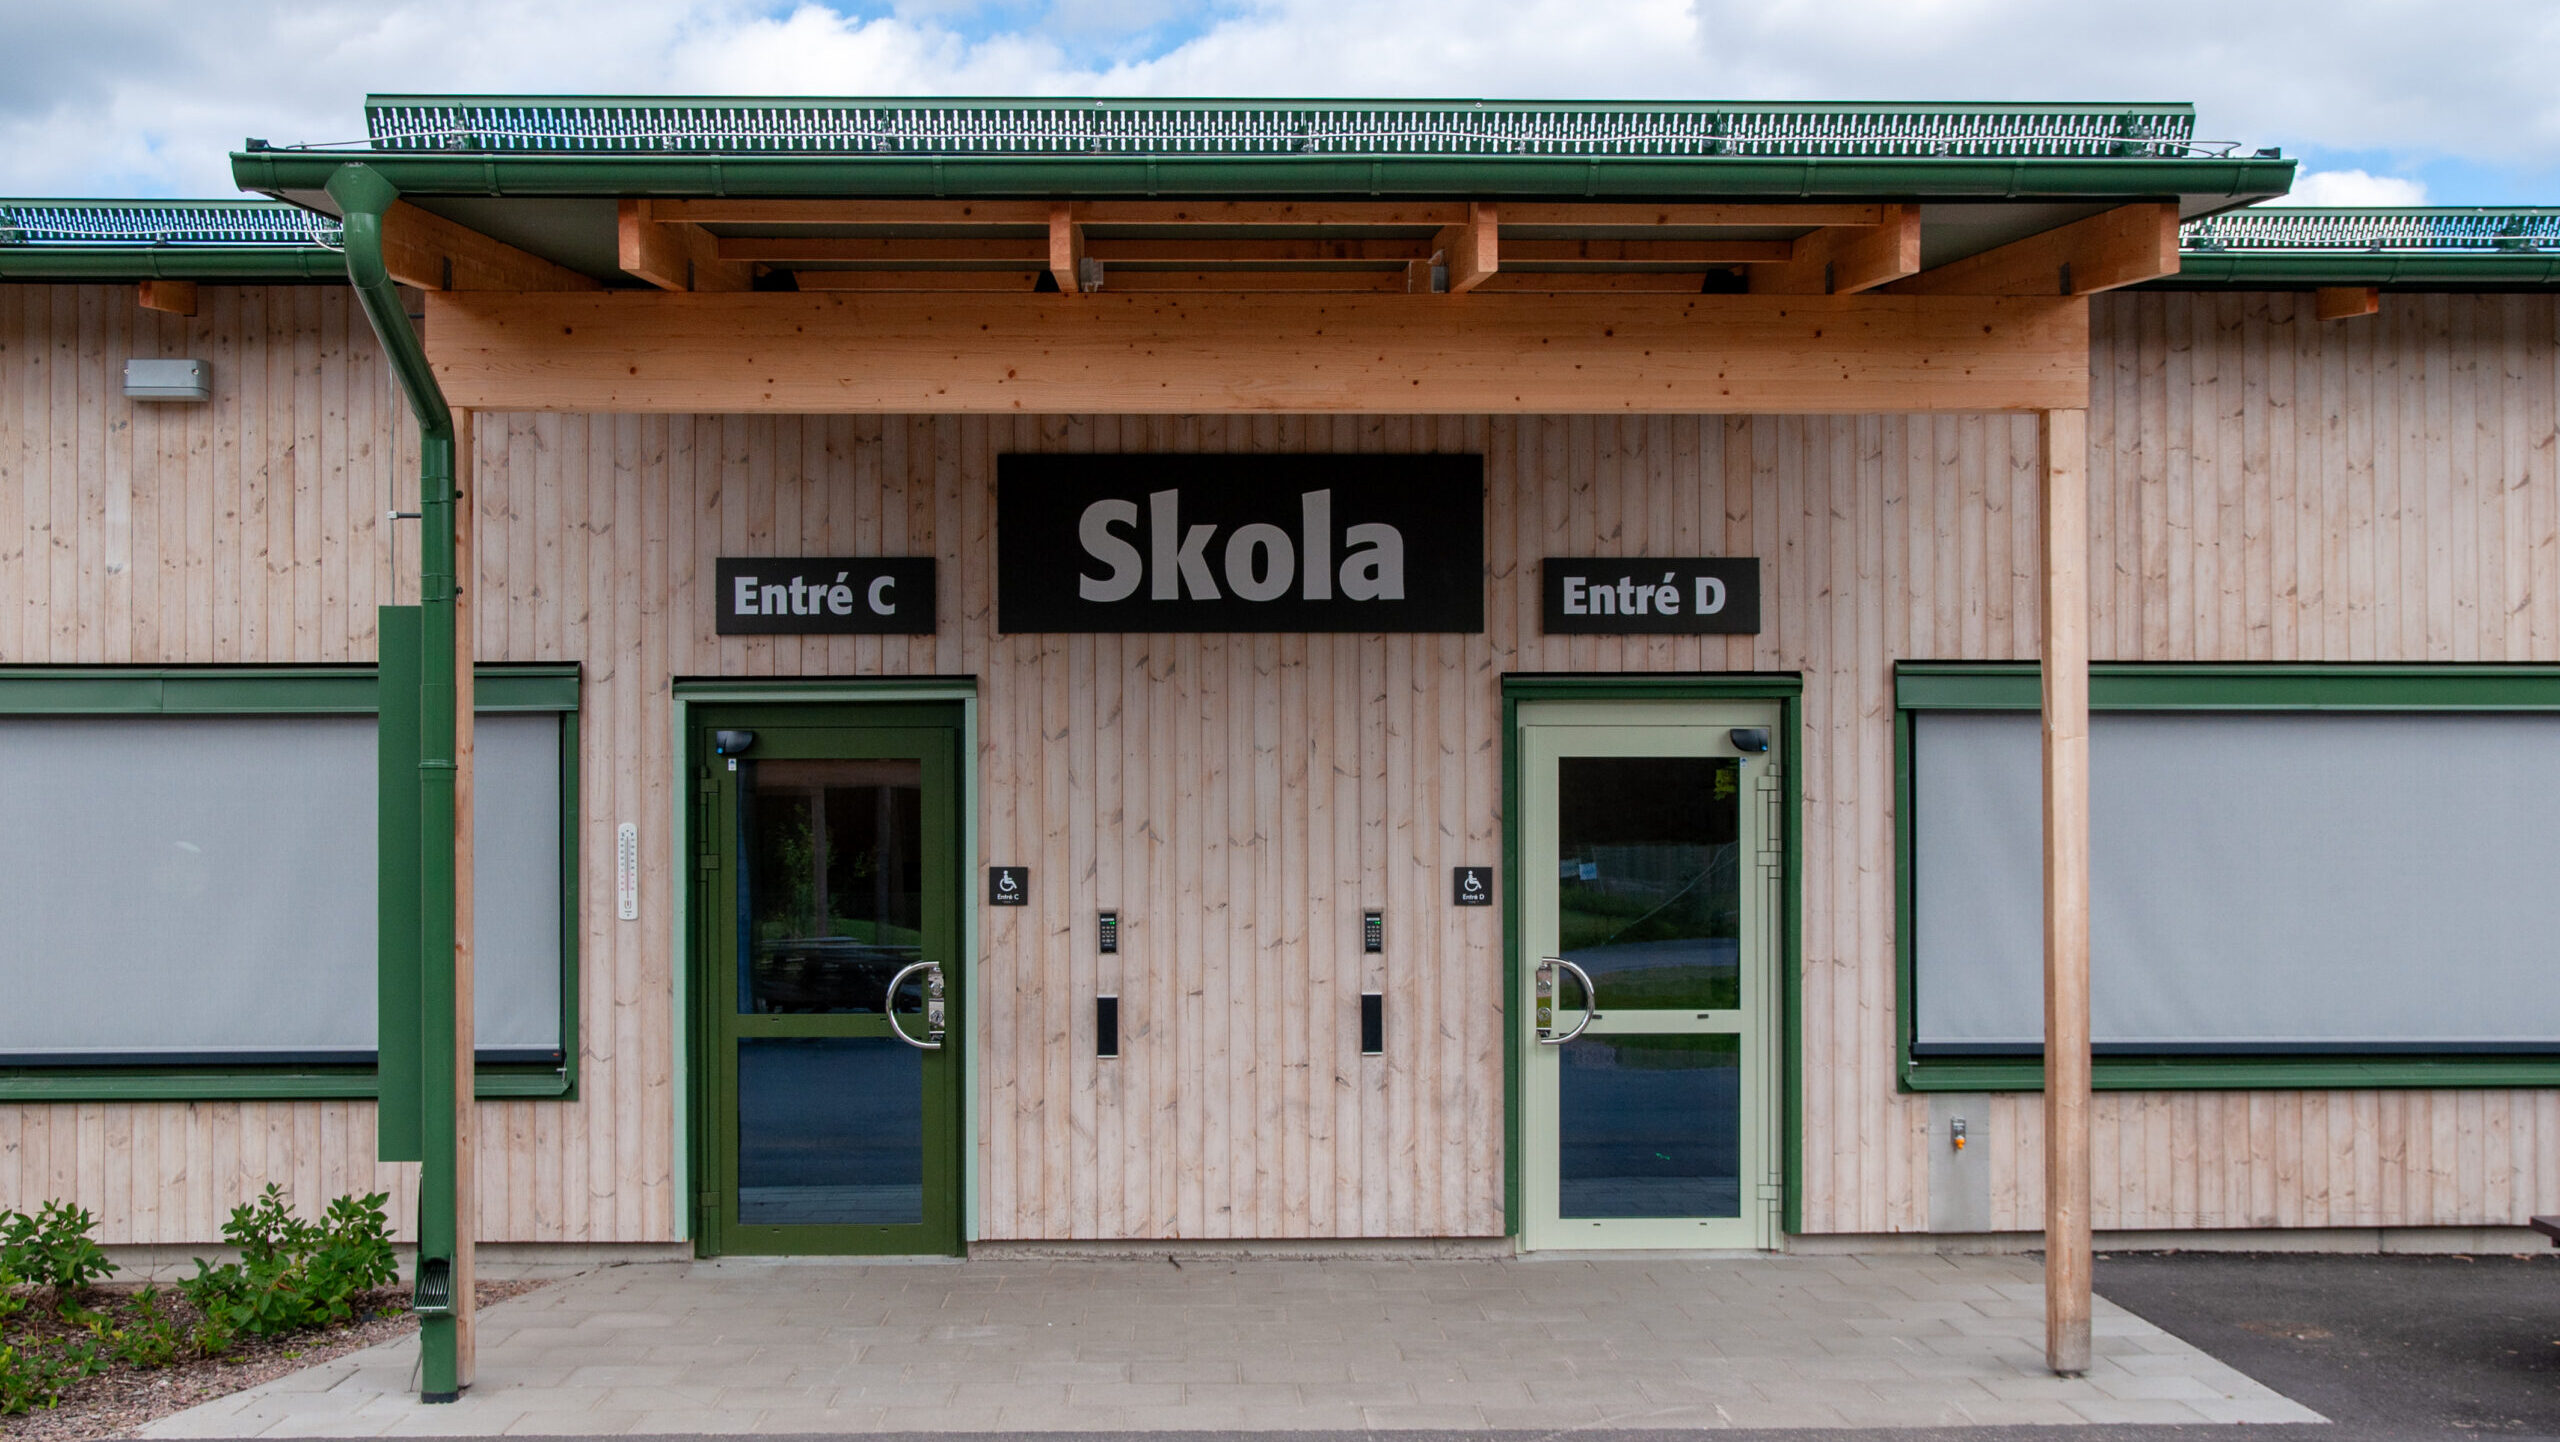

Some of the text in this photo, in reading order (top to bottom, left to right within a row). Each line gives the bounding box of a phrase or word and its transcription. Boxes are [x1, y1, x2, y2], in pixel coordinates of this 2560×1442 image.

[1078, 487, 1406, 602] Skola
[734, 572, 896, 615] Entré C
[1563, 572, 1726, 615] Entré D
